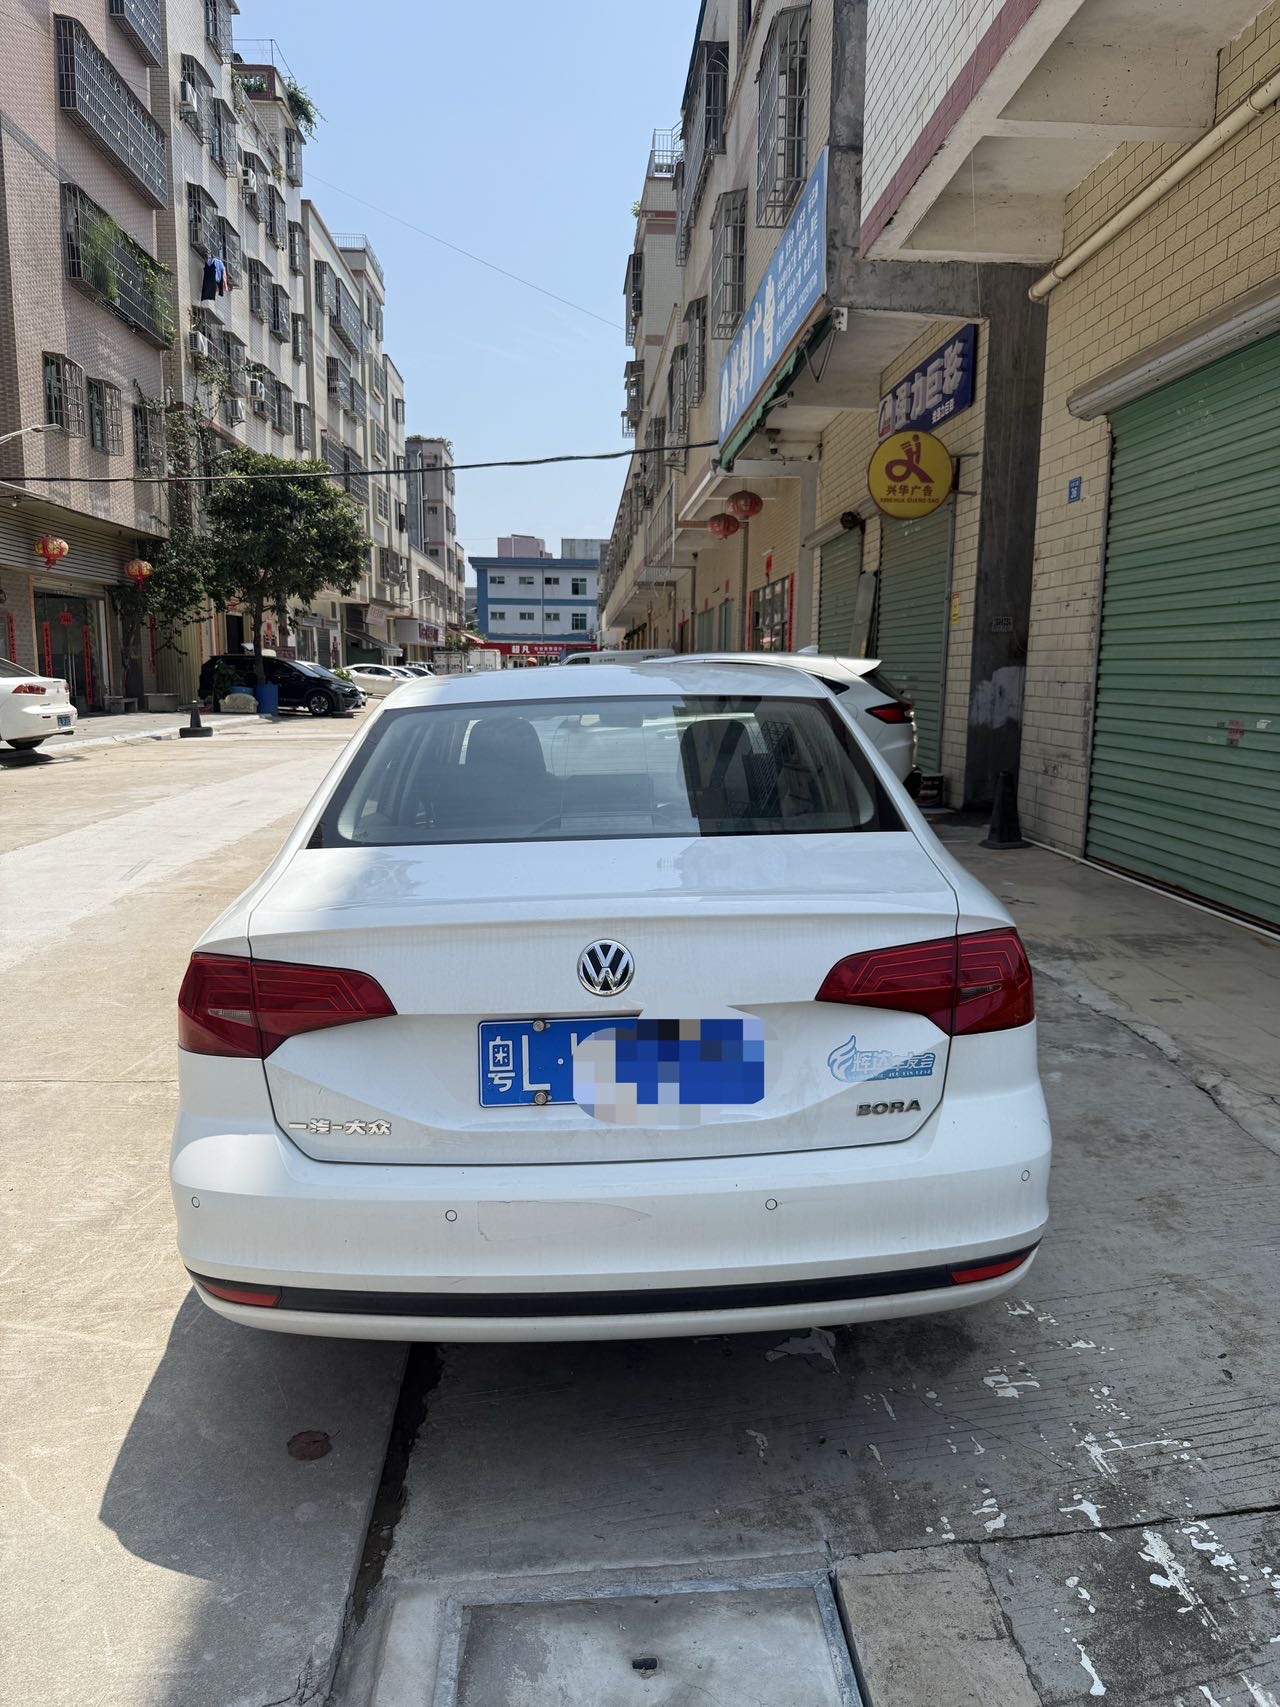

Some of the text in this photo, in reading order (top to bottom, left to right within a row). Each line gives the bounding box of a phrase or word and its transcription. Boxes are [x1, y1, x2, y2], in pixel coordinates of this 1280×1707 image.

[895, 340, 964, 431] 强力巨彩
[887, 485, 933, 497] 兴华广告
[856, 1099, 921, 1116] BORA
[288, 1119, 391, 1135] 一汽-大众
